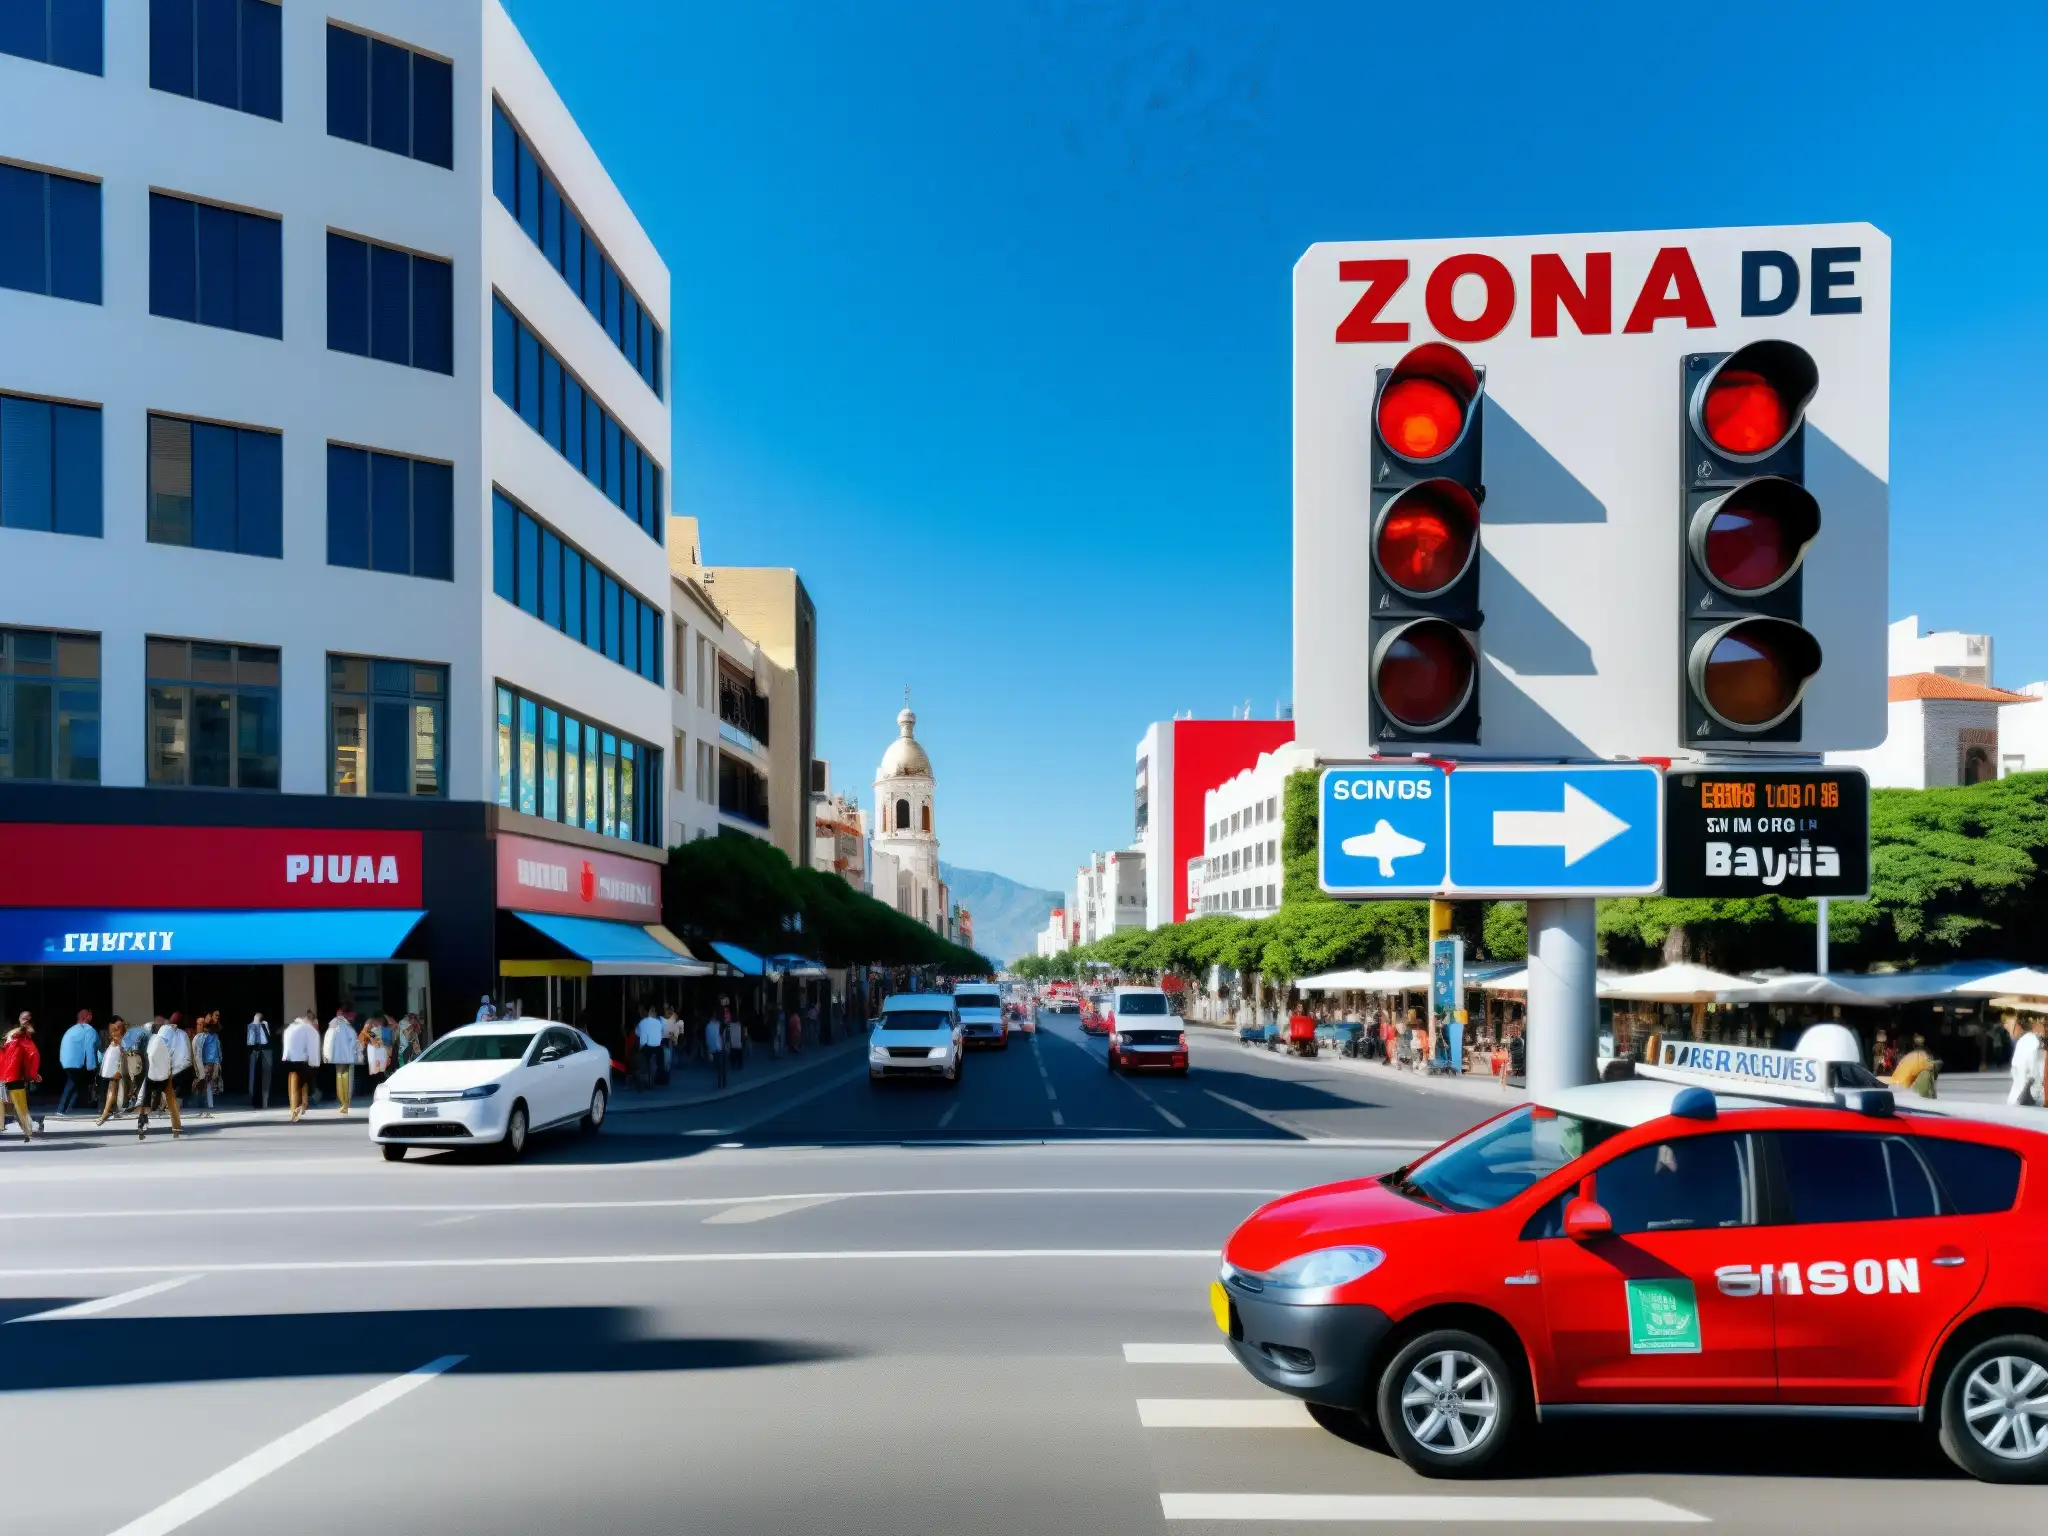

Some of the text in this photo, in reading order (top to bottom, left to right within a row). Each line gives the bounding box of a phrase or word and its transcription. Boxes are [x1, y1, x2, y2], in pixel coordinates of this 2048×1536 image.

[1335, 246, 1863, 343] ZONA DE
[286, 854, 399, 884] PJUAA
